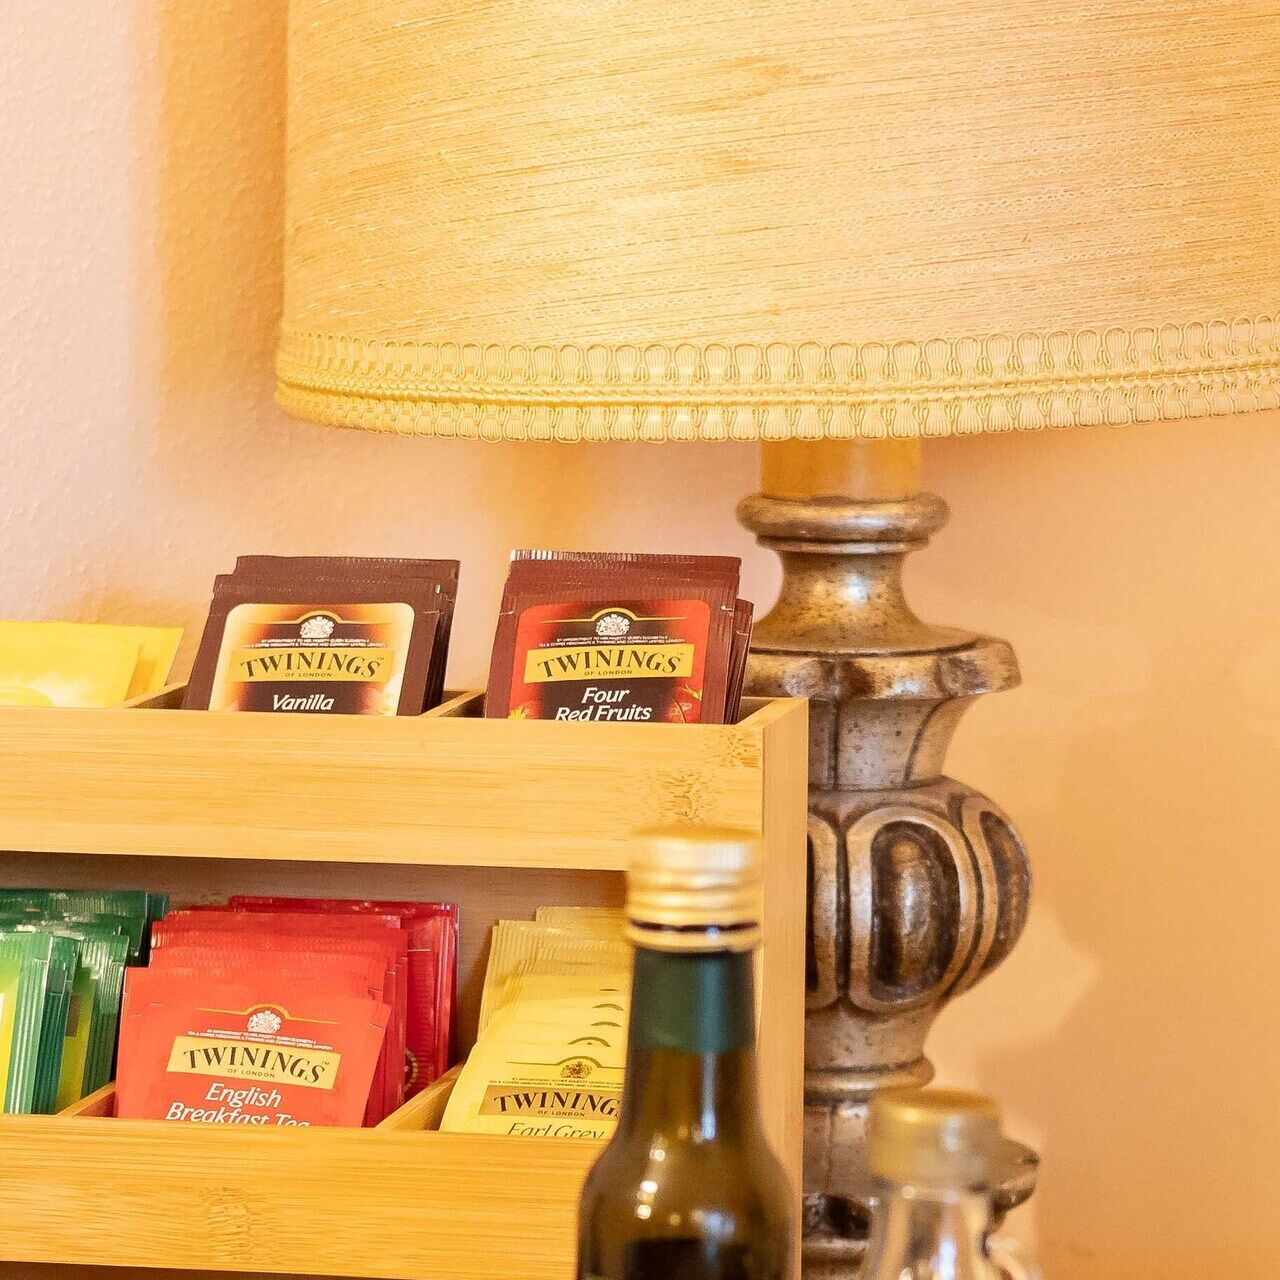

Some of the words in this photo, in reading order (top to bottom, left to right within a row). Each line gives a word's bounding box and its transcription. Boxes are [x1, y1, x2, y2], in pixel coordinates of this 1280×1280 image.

[240, 652, 381, 678] TWININGS
[538, 650, 681, 678] TWININGS
[273, 694, 335, 711] Vanilla
[581, 687, 630, 703] Four
[555, 705, 594, 721] Red
[595, 704, 652, 721] Fruits
[183, 1046, 325, 1084] TWININGS
[241, 1069, 275, 1078] LONDON
[204, 1082, 282, 1108] English
[493, 1092, 620, 1117] TWINING
[165, 1101, 271, 1125] Breakfast
